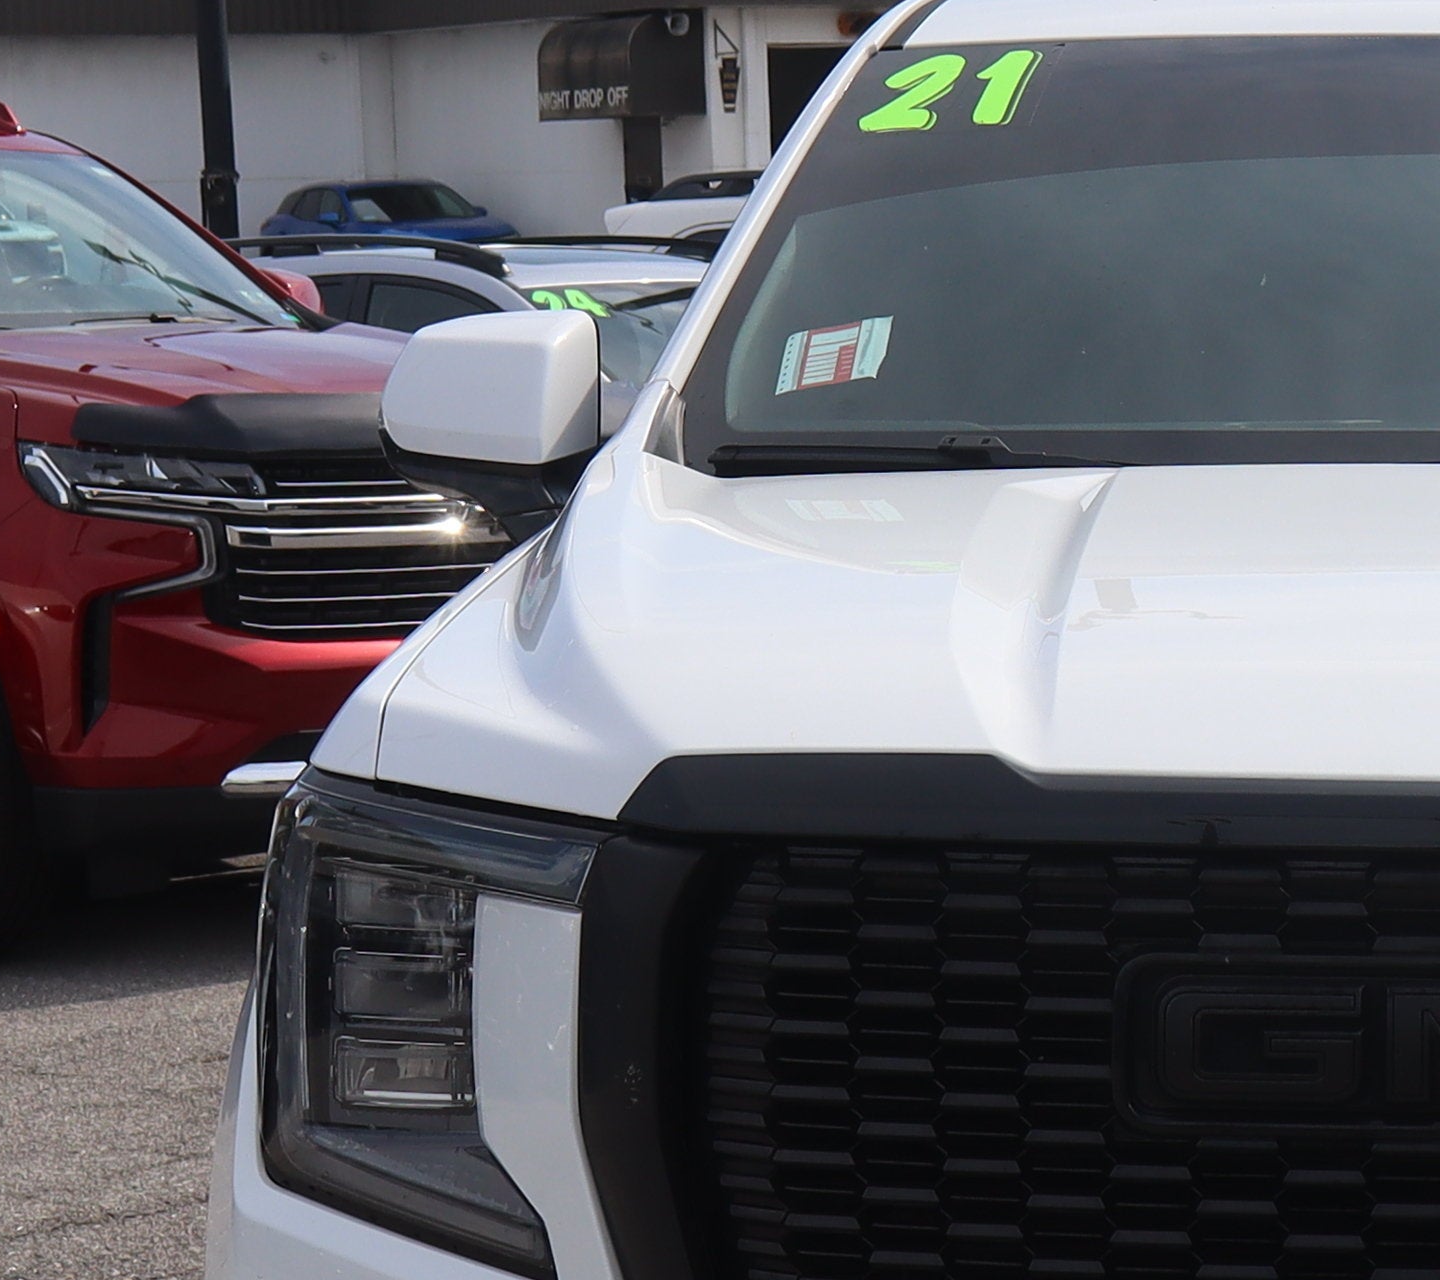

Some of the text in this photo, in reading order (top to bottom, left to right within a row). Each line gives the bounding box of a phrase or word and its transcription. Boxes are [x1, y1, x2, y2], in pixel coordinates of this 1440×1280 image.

[538, 85, 629, 112] NIGHT DROP OFF
[858, 49, 1043, 132] 21
